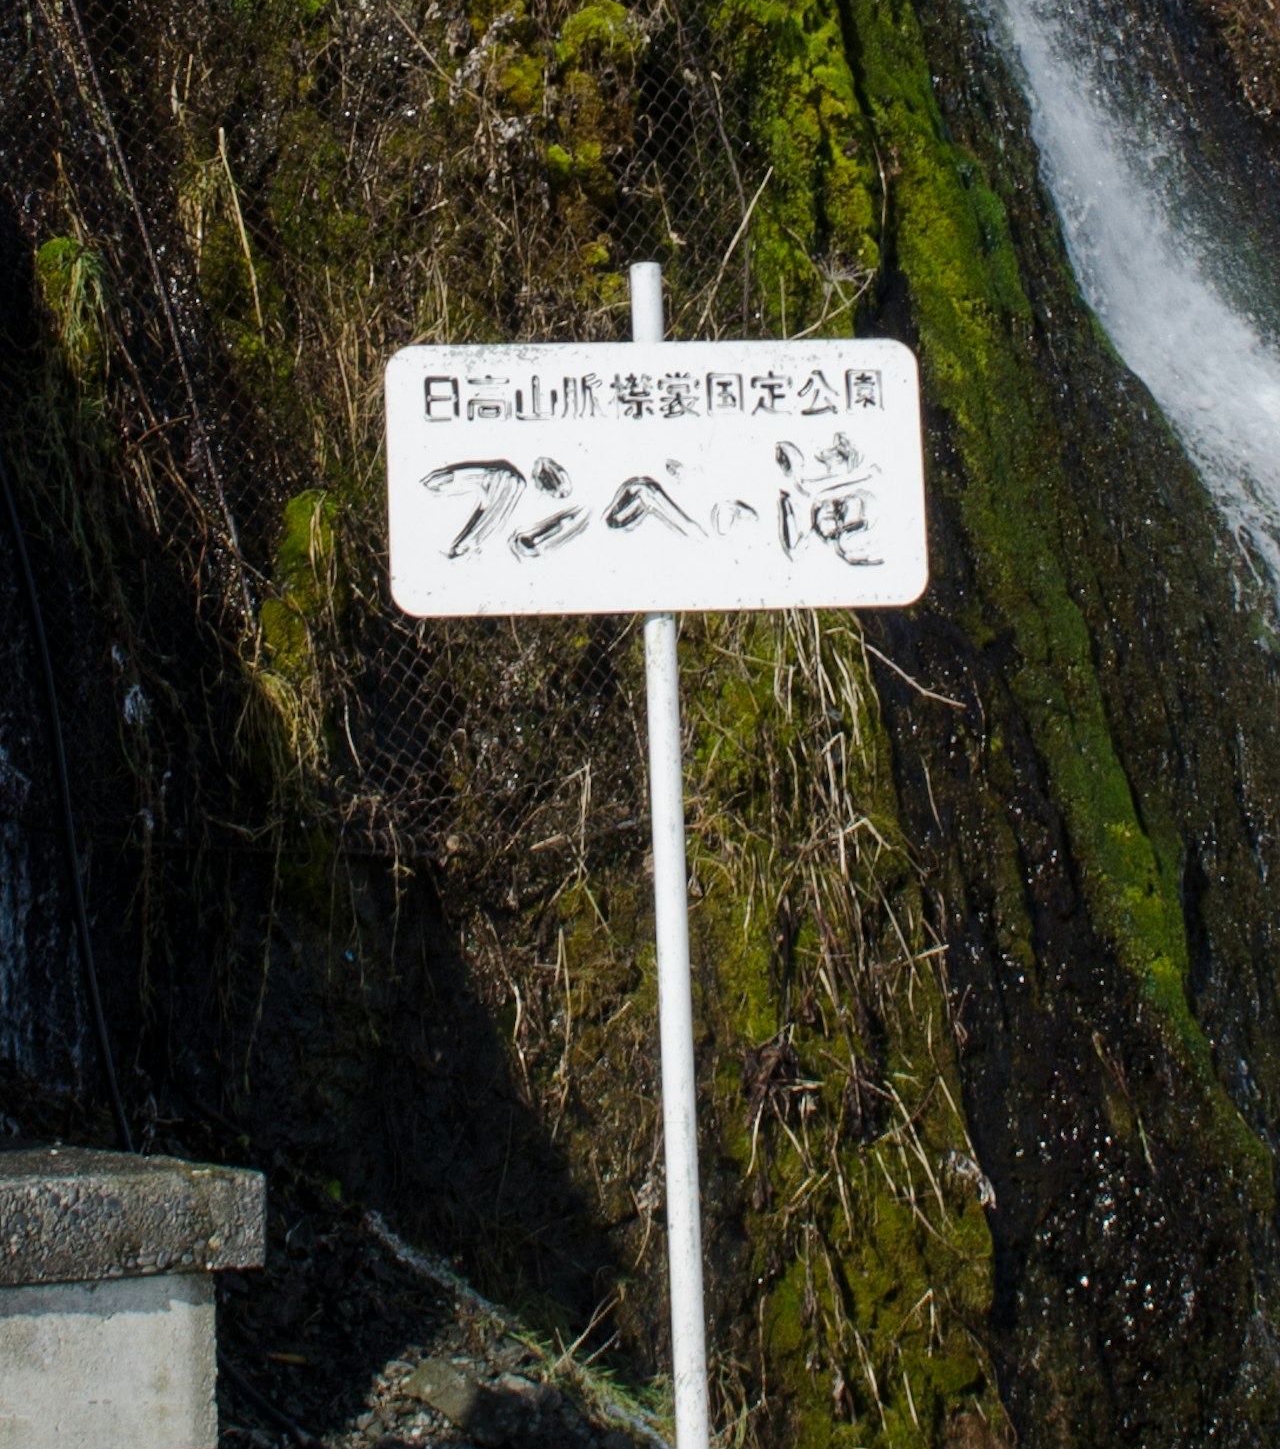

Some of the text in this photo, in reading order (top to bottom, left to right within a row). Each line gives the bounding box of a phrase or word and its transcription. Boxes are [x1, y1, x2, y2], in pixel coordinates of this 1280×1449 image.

[423, 369, 884, 422] 日高山脈襟裳国定公園
[419, 432, 884, 566] フンベの滝
